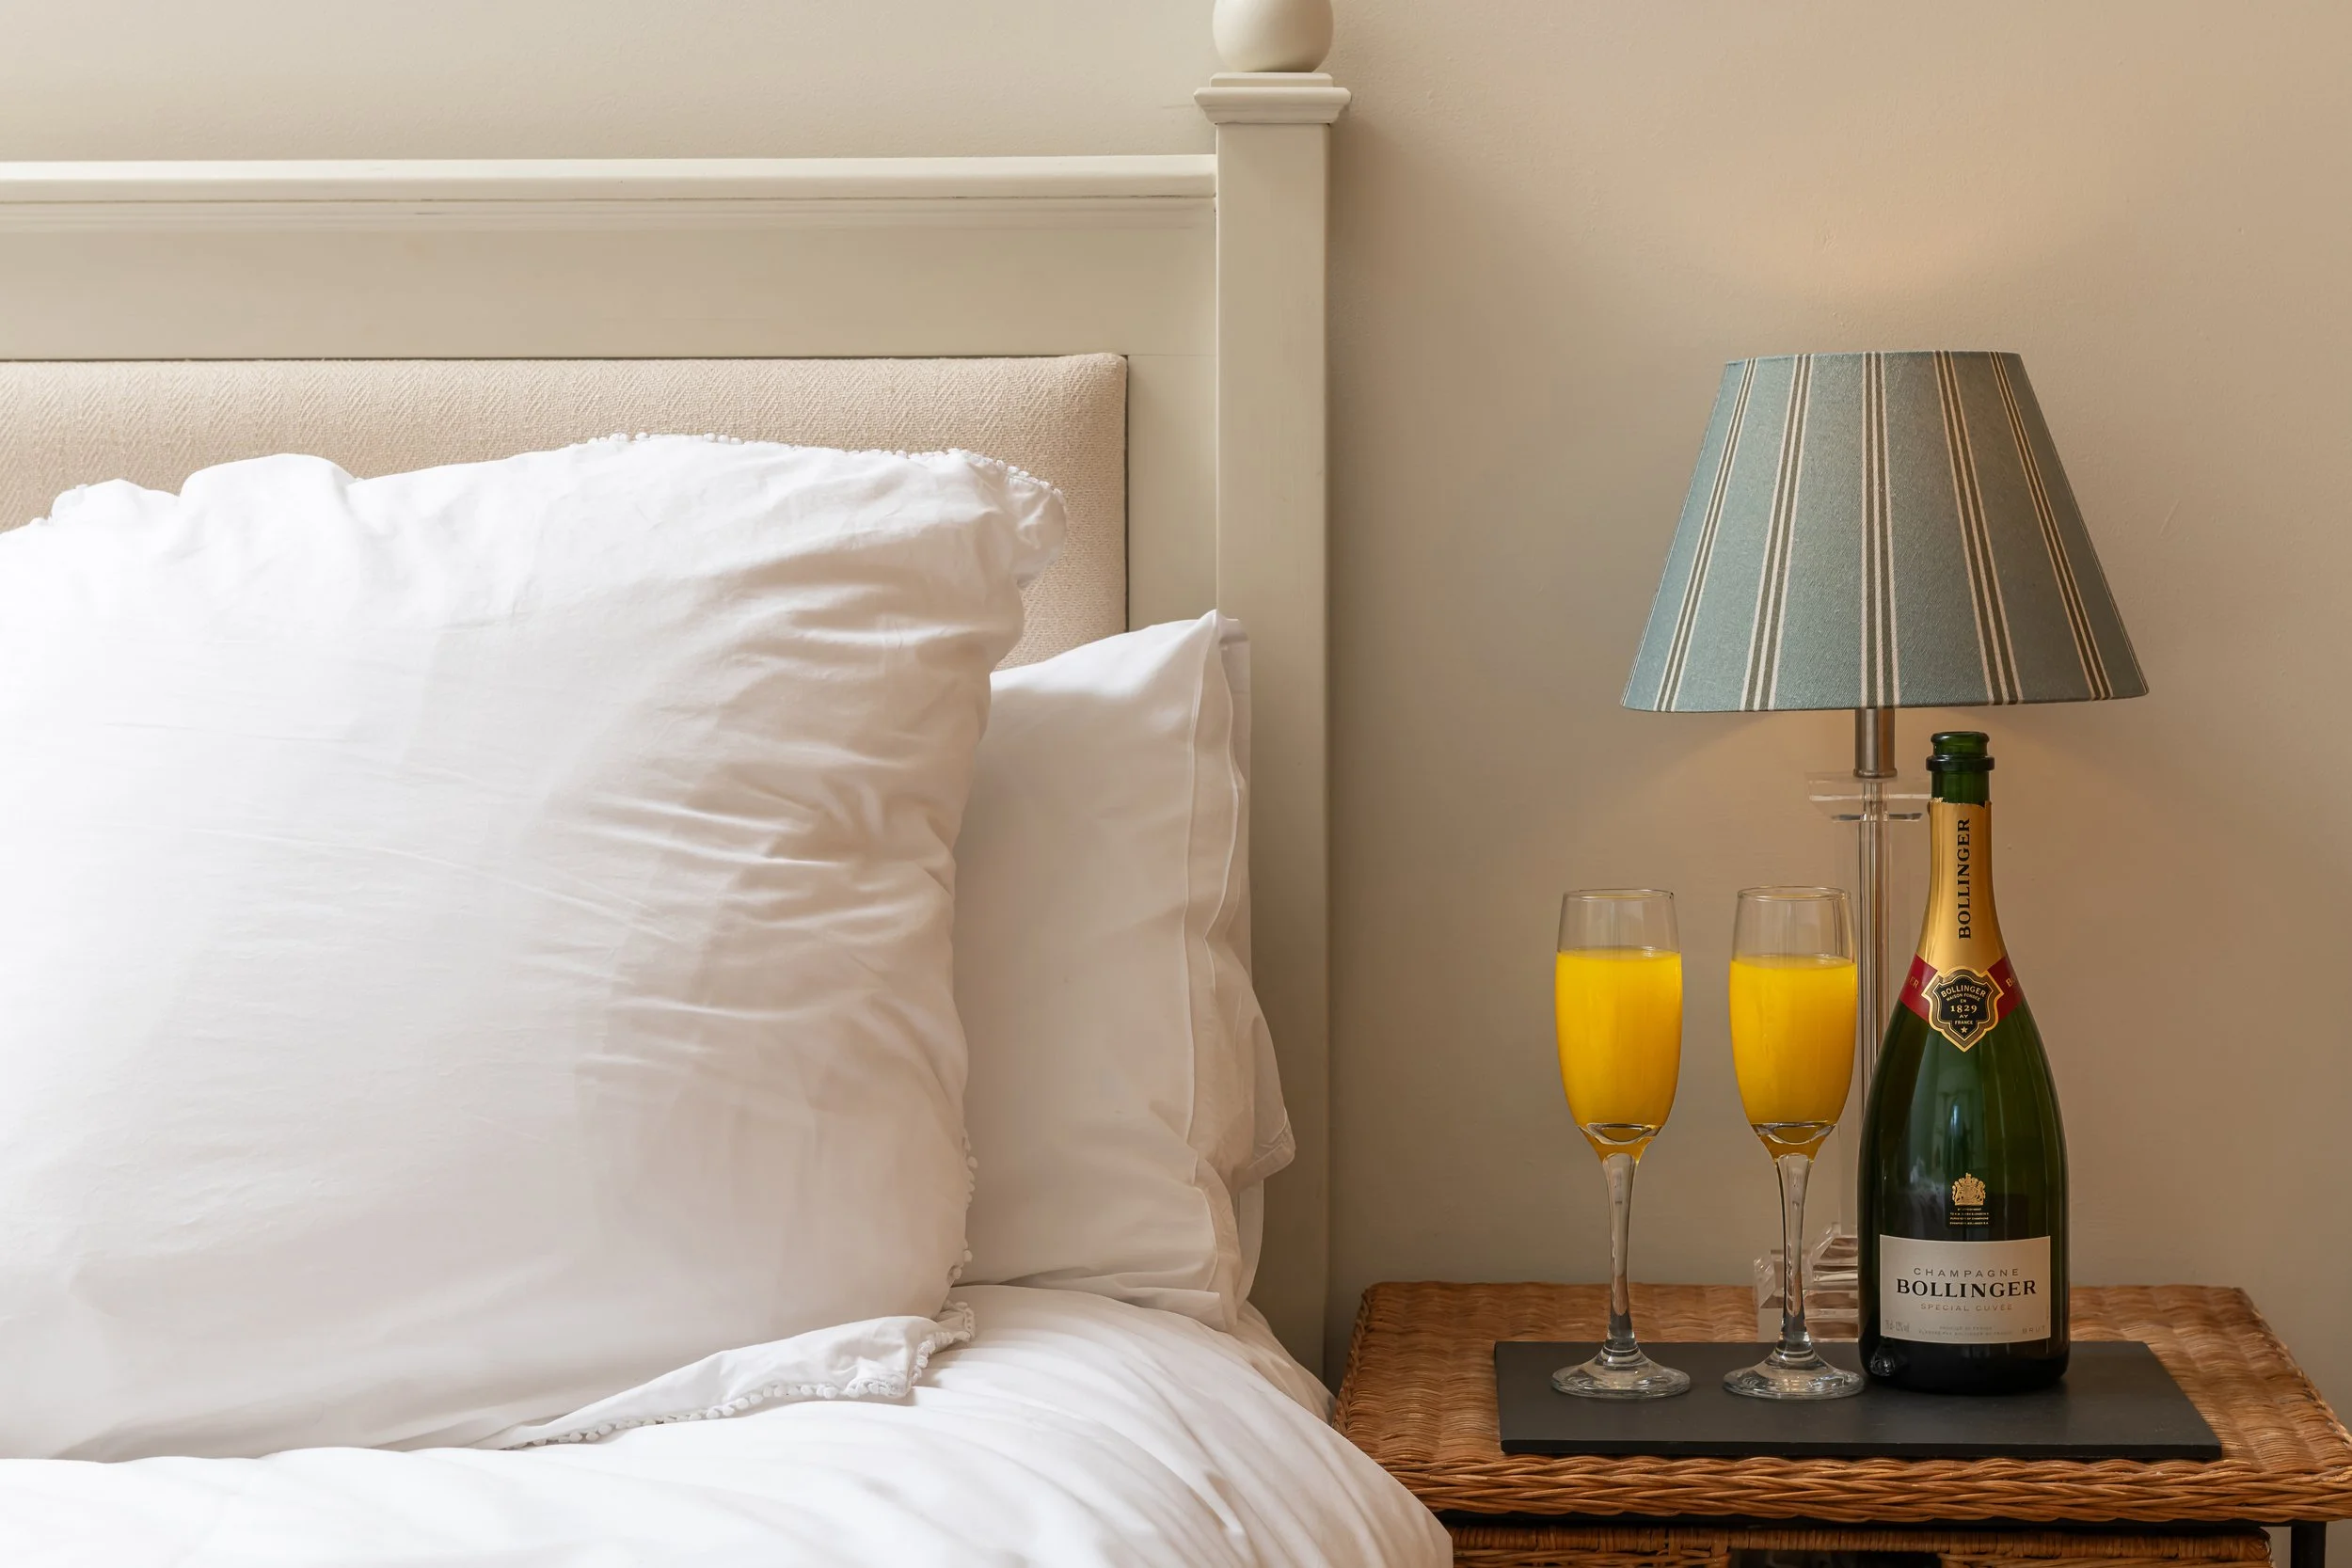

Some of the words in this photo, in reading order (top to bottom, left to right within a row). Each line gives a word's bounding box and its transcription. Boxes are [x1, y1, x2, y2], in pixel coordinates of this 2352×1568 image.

[1957, 817, 1972, 940] BOLLINGER
[1940, 984, 1987, 998] BOLLINGER
[1949, 1004, 1978, 1014] 1829
[1914, 1267, 2019, 1277] CHAMPAGNE
[1896, 1278, 2037, 1298] BOLLINGER
[1920, 1303, 1970, 1311] SPECIAL
